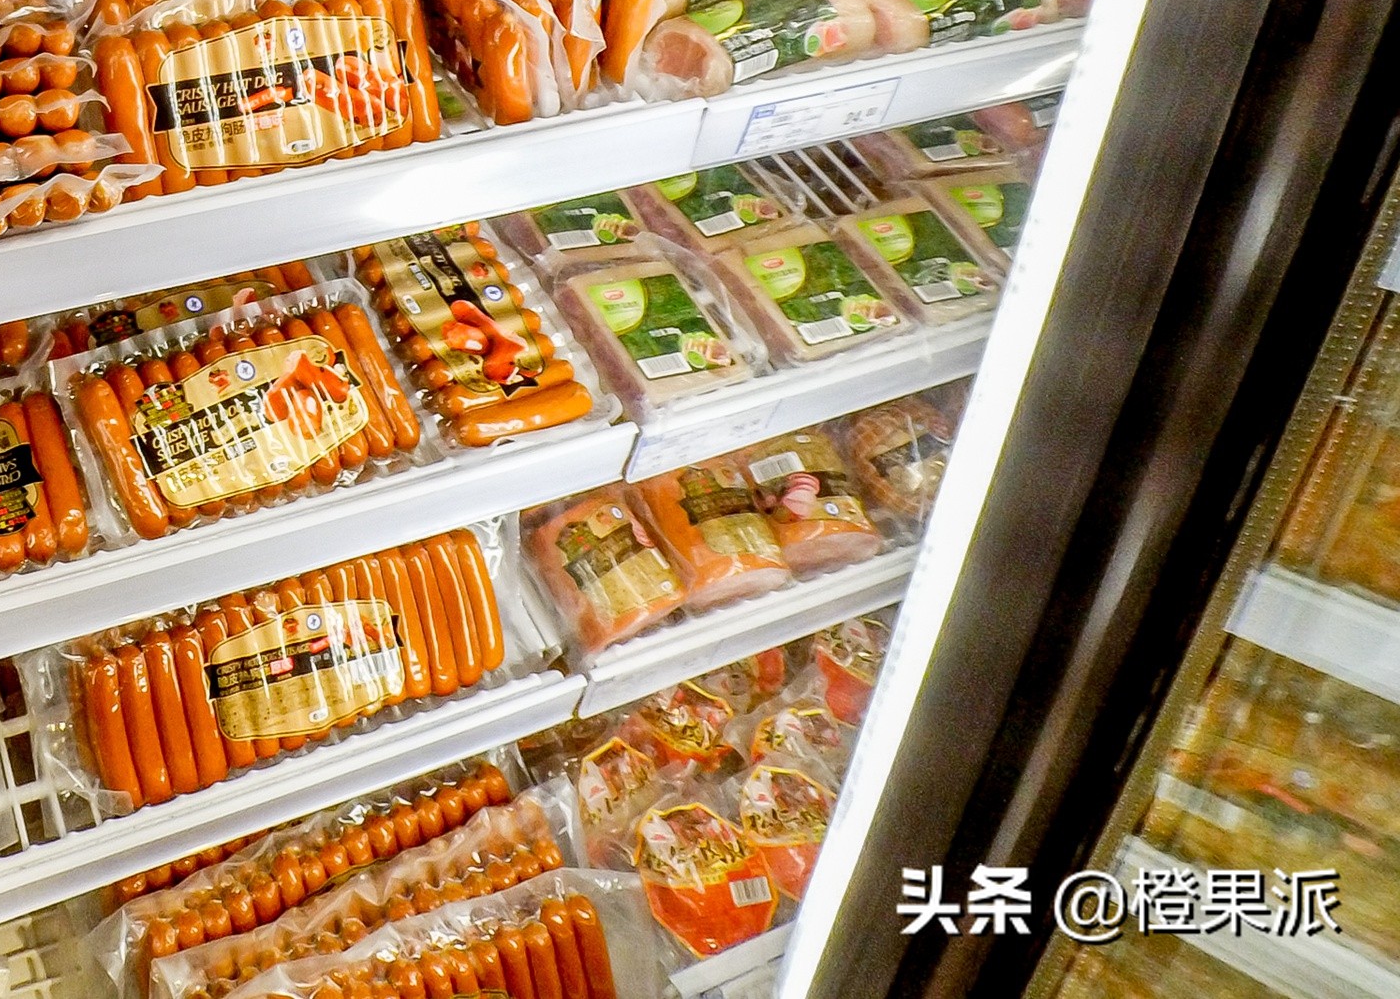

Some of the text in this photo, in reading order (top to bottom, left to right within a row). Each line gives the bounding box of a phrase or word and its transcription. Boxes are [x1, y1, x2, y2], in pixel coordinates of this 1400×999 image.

[174, 84, 219, 102] CRISY
[223, 77, 252, 94] HT
[176, 95, 237, 115] SAUSGE
